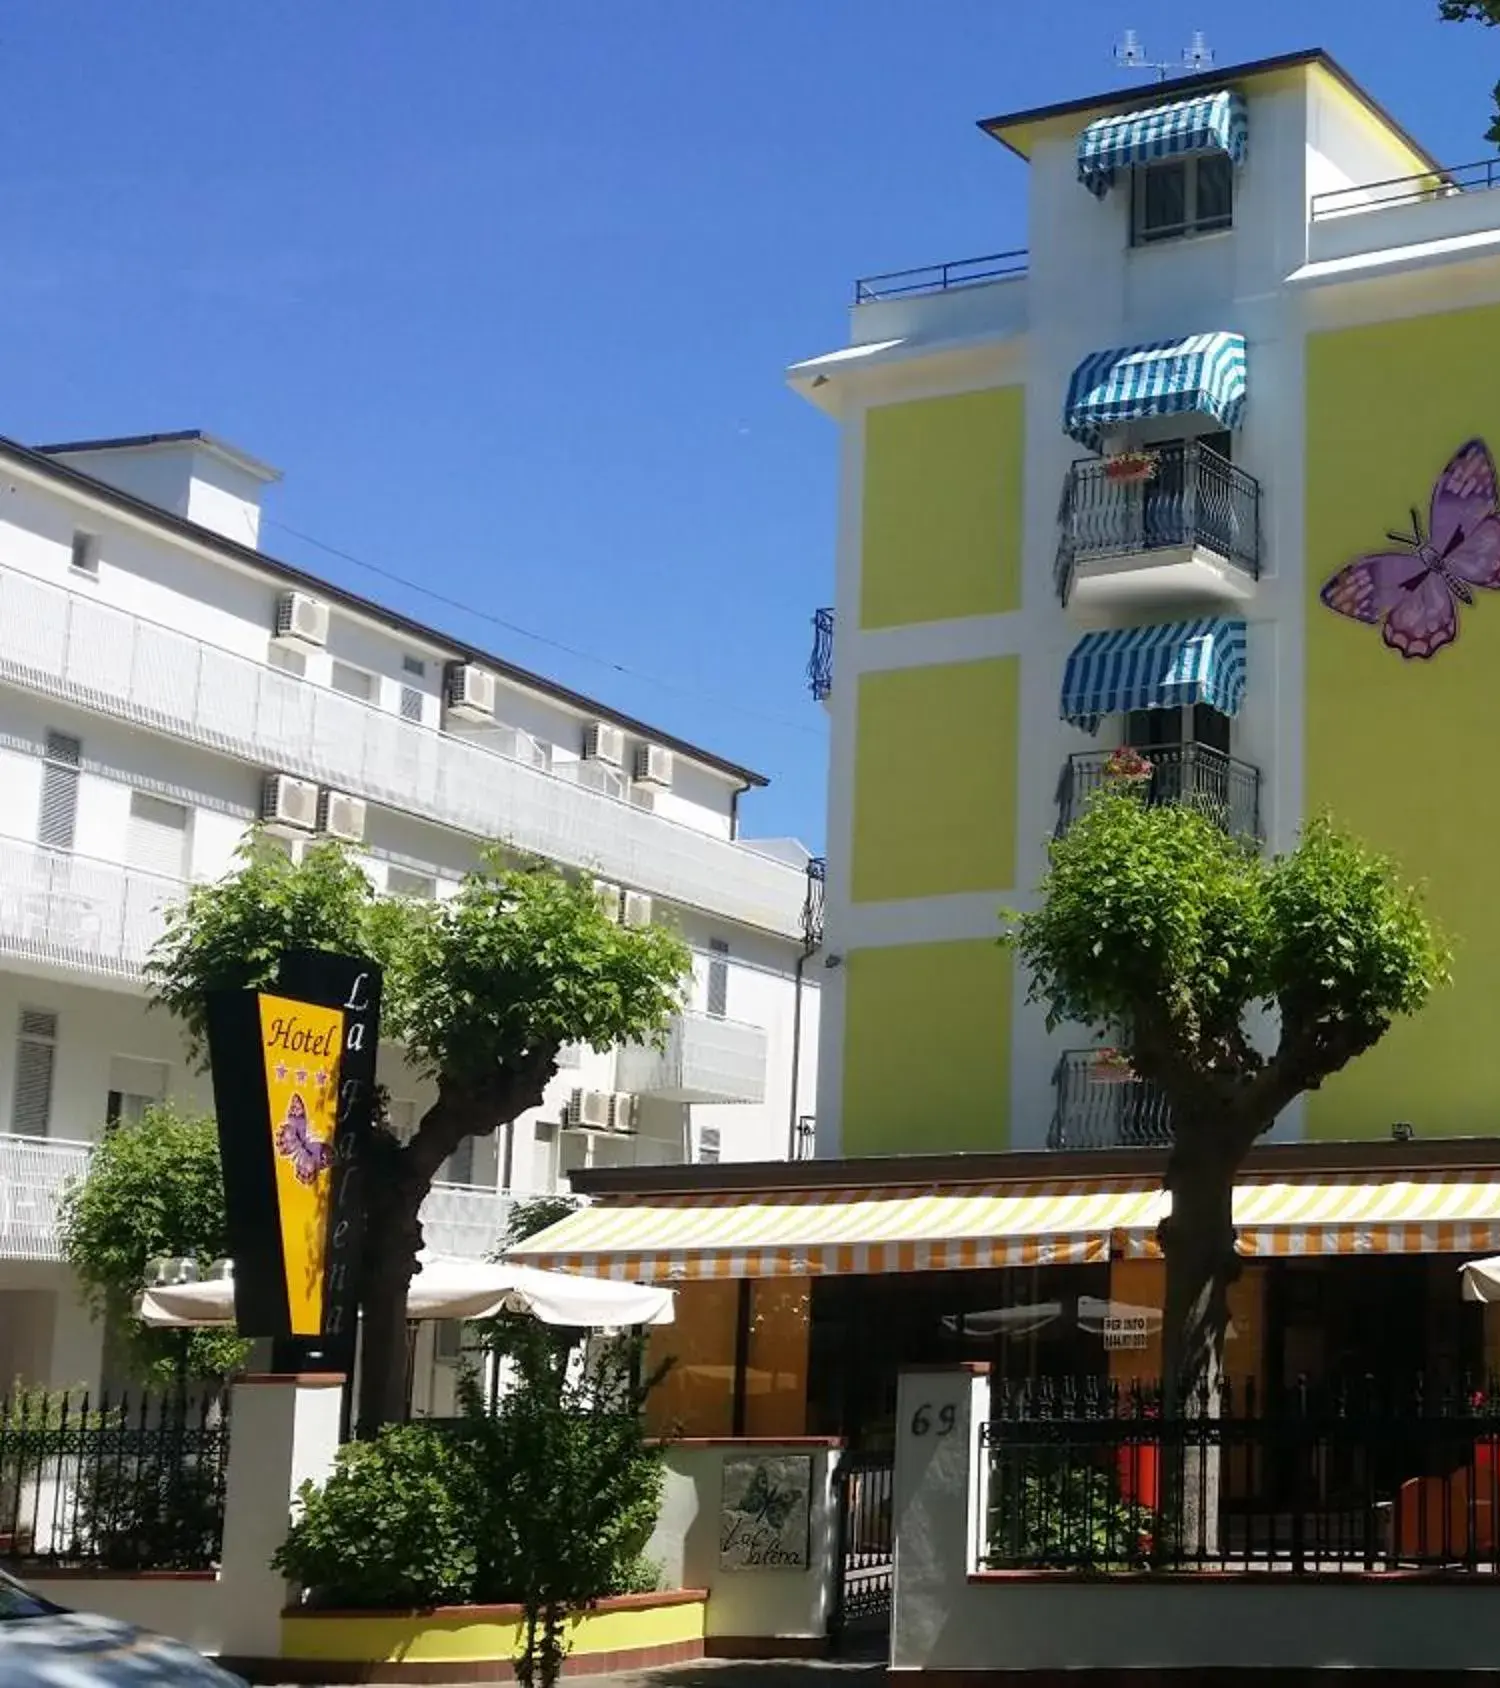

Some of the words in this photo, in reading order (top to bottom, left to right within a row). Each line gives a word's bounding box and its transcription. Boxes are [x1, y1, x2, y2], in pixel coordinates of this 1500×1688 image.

[344, 972, 370, 1052] La
[267, 1017, 335, 1057] Hotel
[911, 1403, 957, 1436] 69
